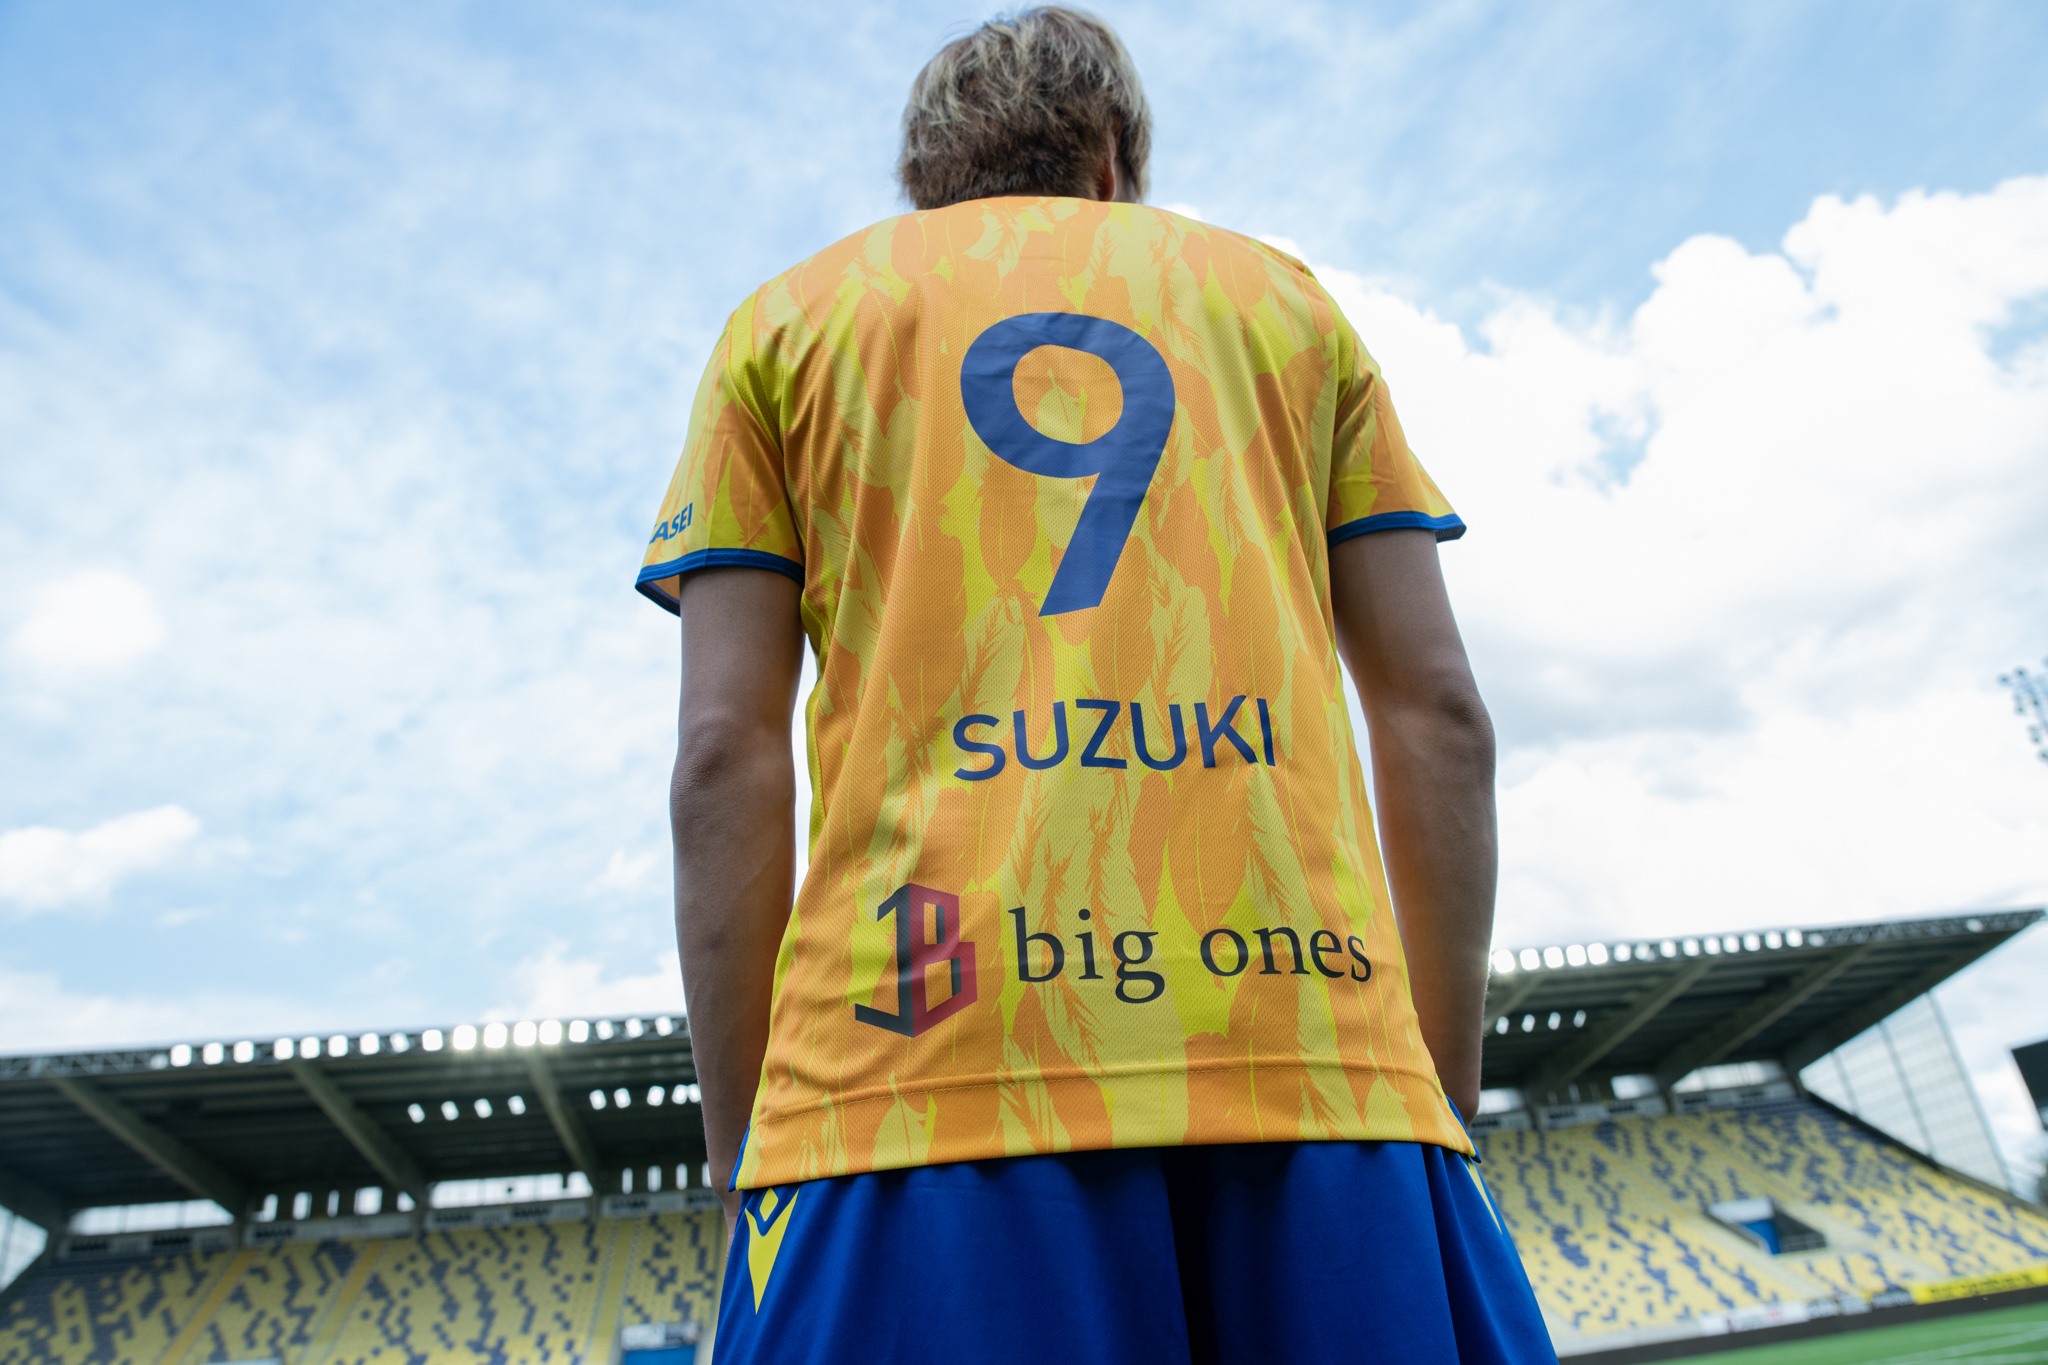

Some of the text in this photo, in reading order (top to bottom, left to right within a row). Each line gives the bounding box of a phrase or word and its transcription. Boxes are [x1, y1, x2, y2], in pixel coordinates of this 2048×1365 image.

[960, 311, 1176, 617] 9
[649, 502, 693, 545] ASEI
[952, 694, 1276, 782] SUZUKI
[1007, 905, 1166, 1004] big
[1199, 925, 1373, 983] ones
